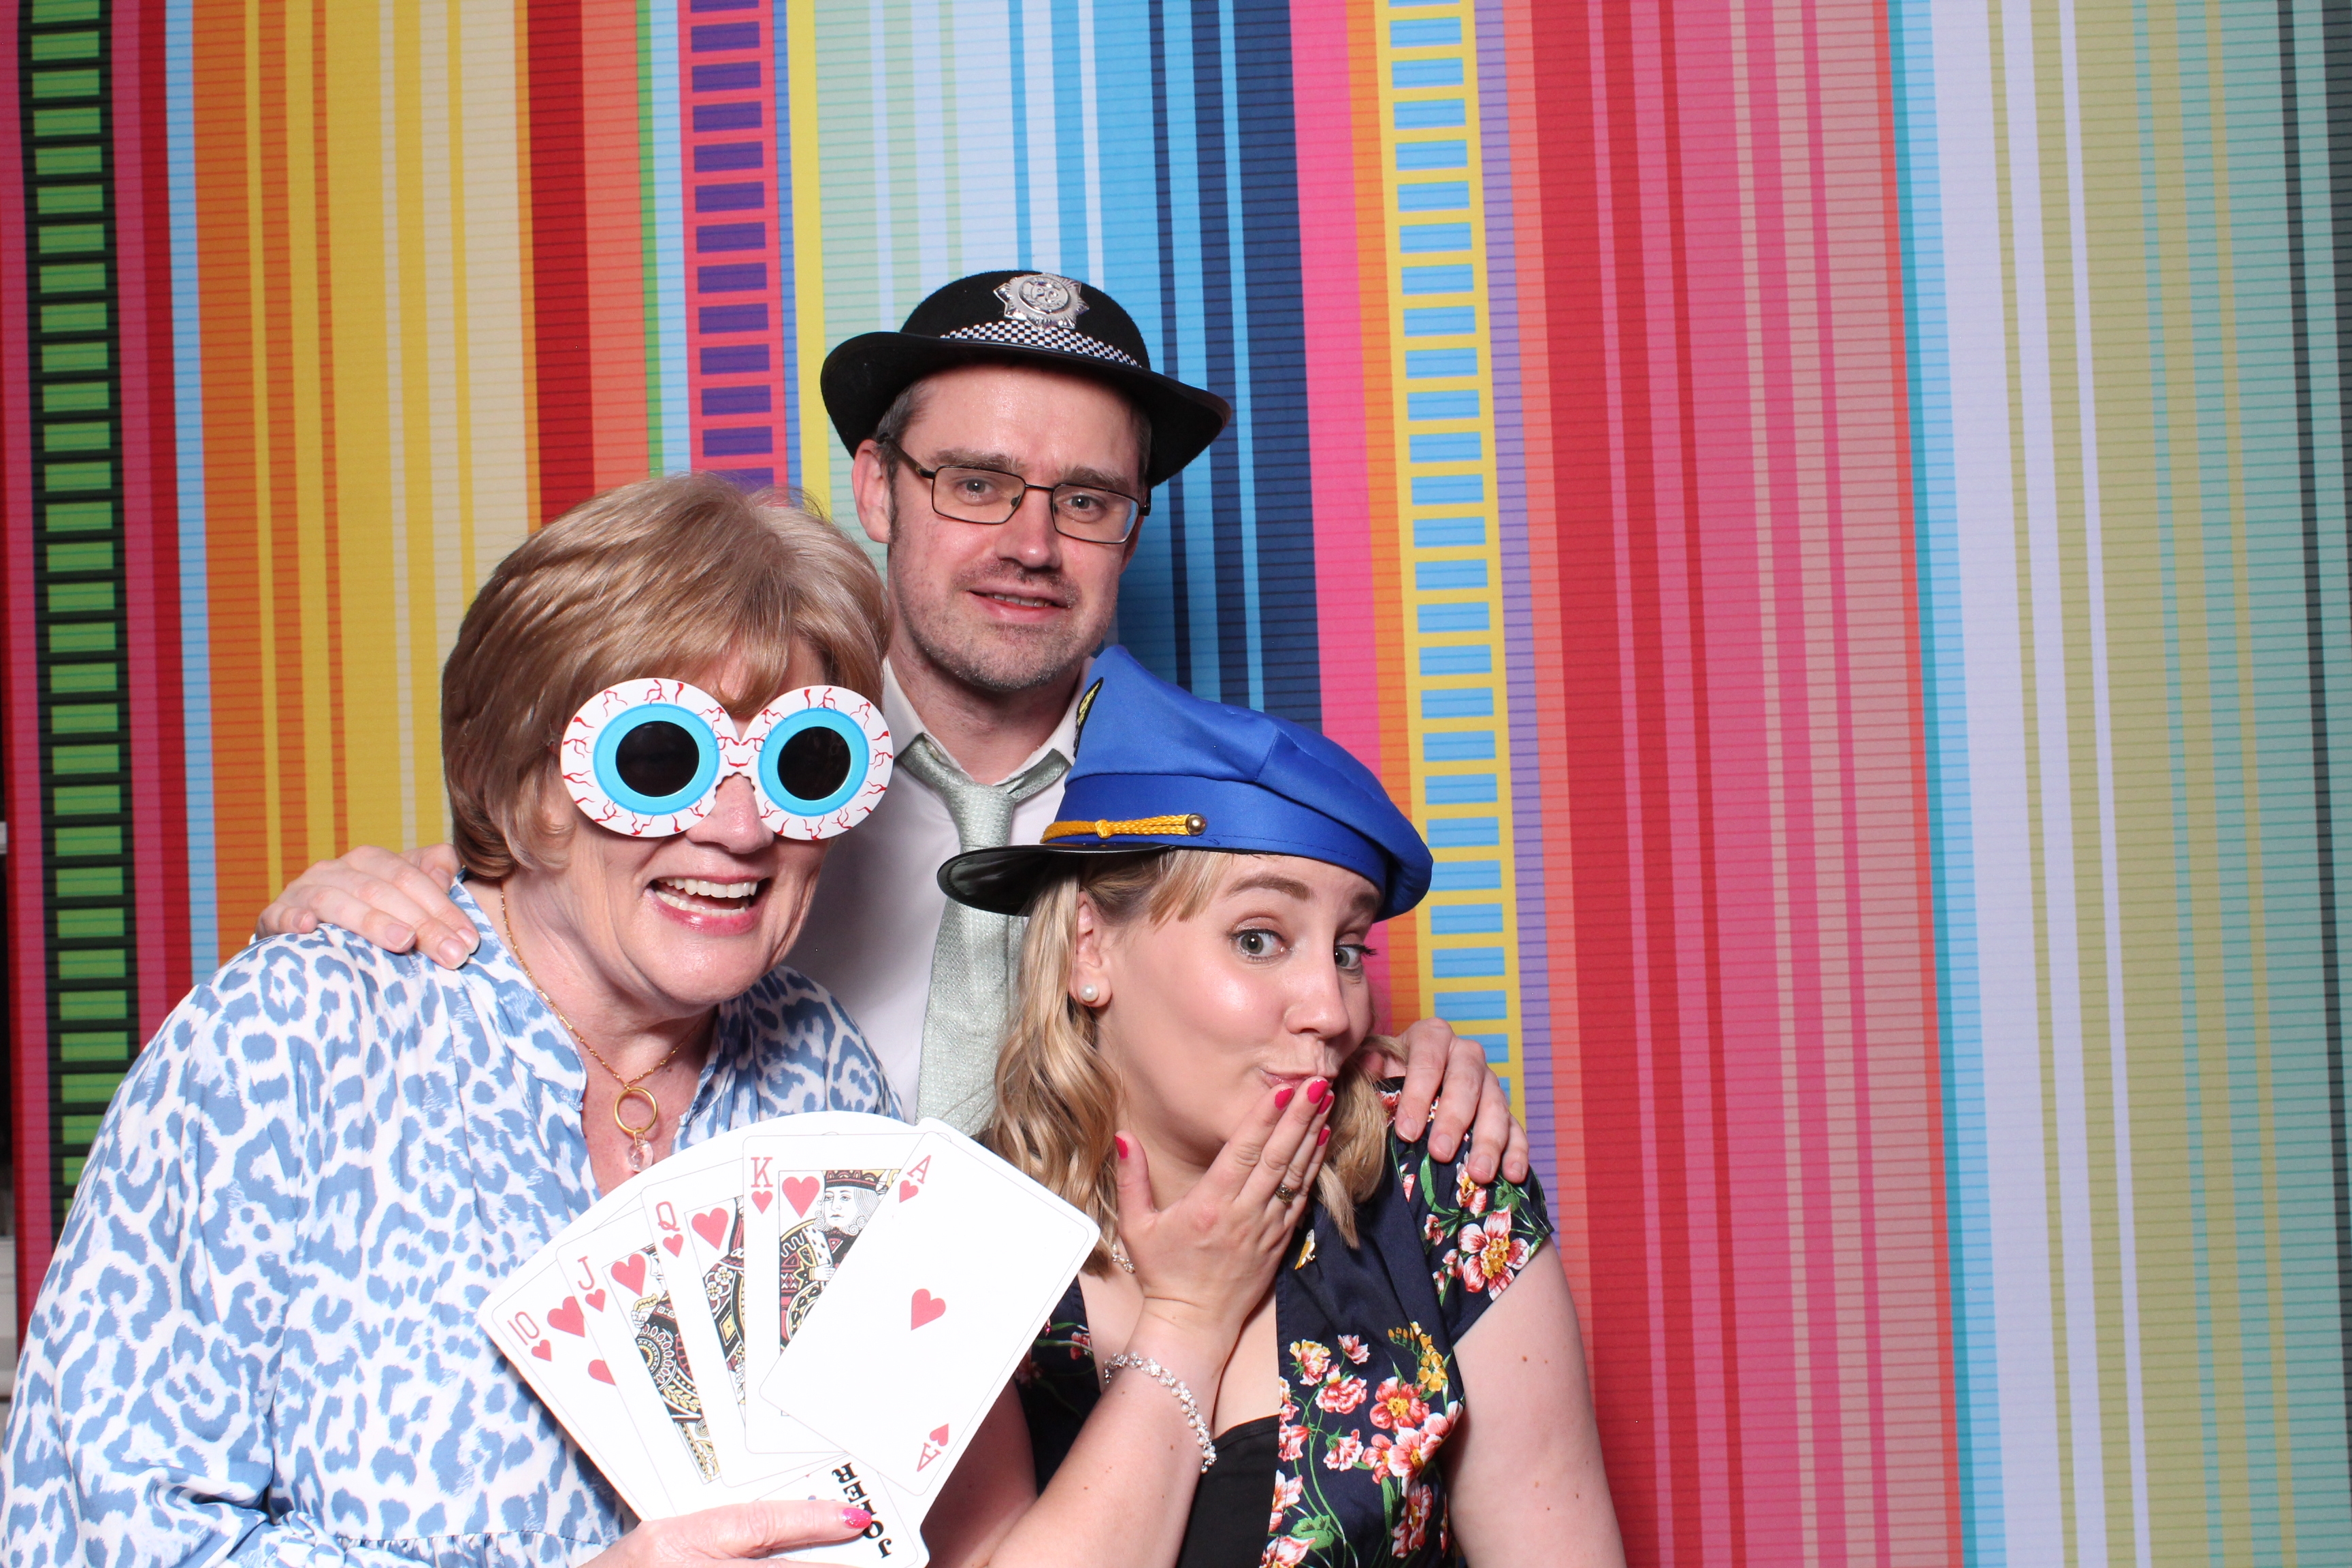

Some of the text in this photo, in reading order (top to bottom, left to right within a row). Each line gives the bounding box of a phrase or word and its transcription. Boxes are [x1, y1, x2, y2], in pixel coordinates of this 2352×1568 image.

[750, 1156, 773, 1188] K
[906, 1154, 932, 1184] A
[655, 1200, 681, 1232] Q
[577, 1256, 595, 1290] J
[507, 1311, 540, 1346] 10
[917, 1441, 942, 1472] A
